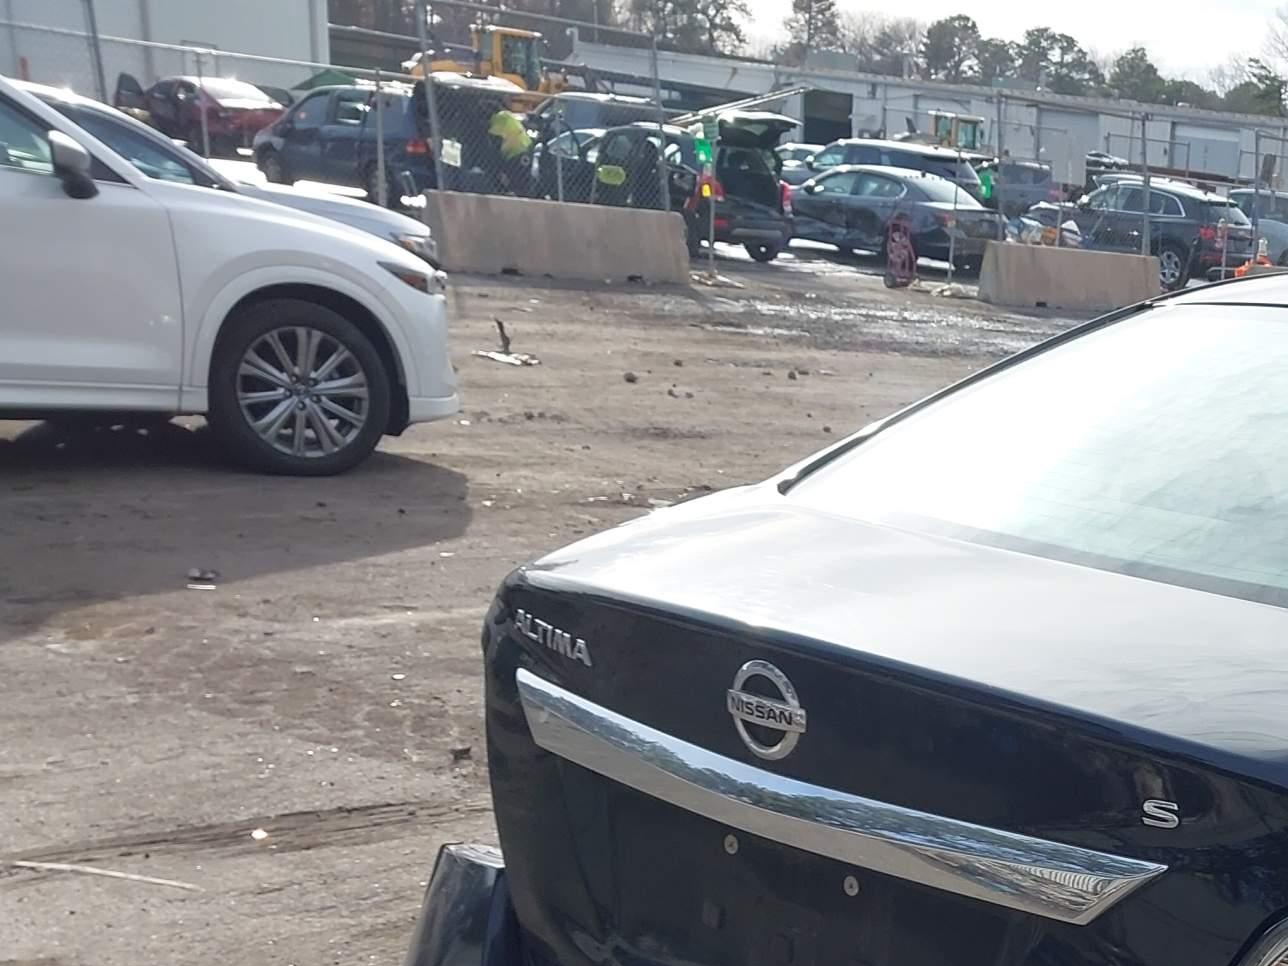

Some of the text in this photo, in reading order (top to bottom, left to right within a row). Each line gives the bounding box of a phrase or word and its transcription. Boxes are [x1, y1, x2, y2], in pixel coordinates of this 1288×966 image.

[514, 608, 593, 667] ALTIMA
[729, 694, 793, 726] NISSAN
[1141, 799, 1179, 829] S
